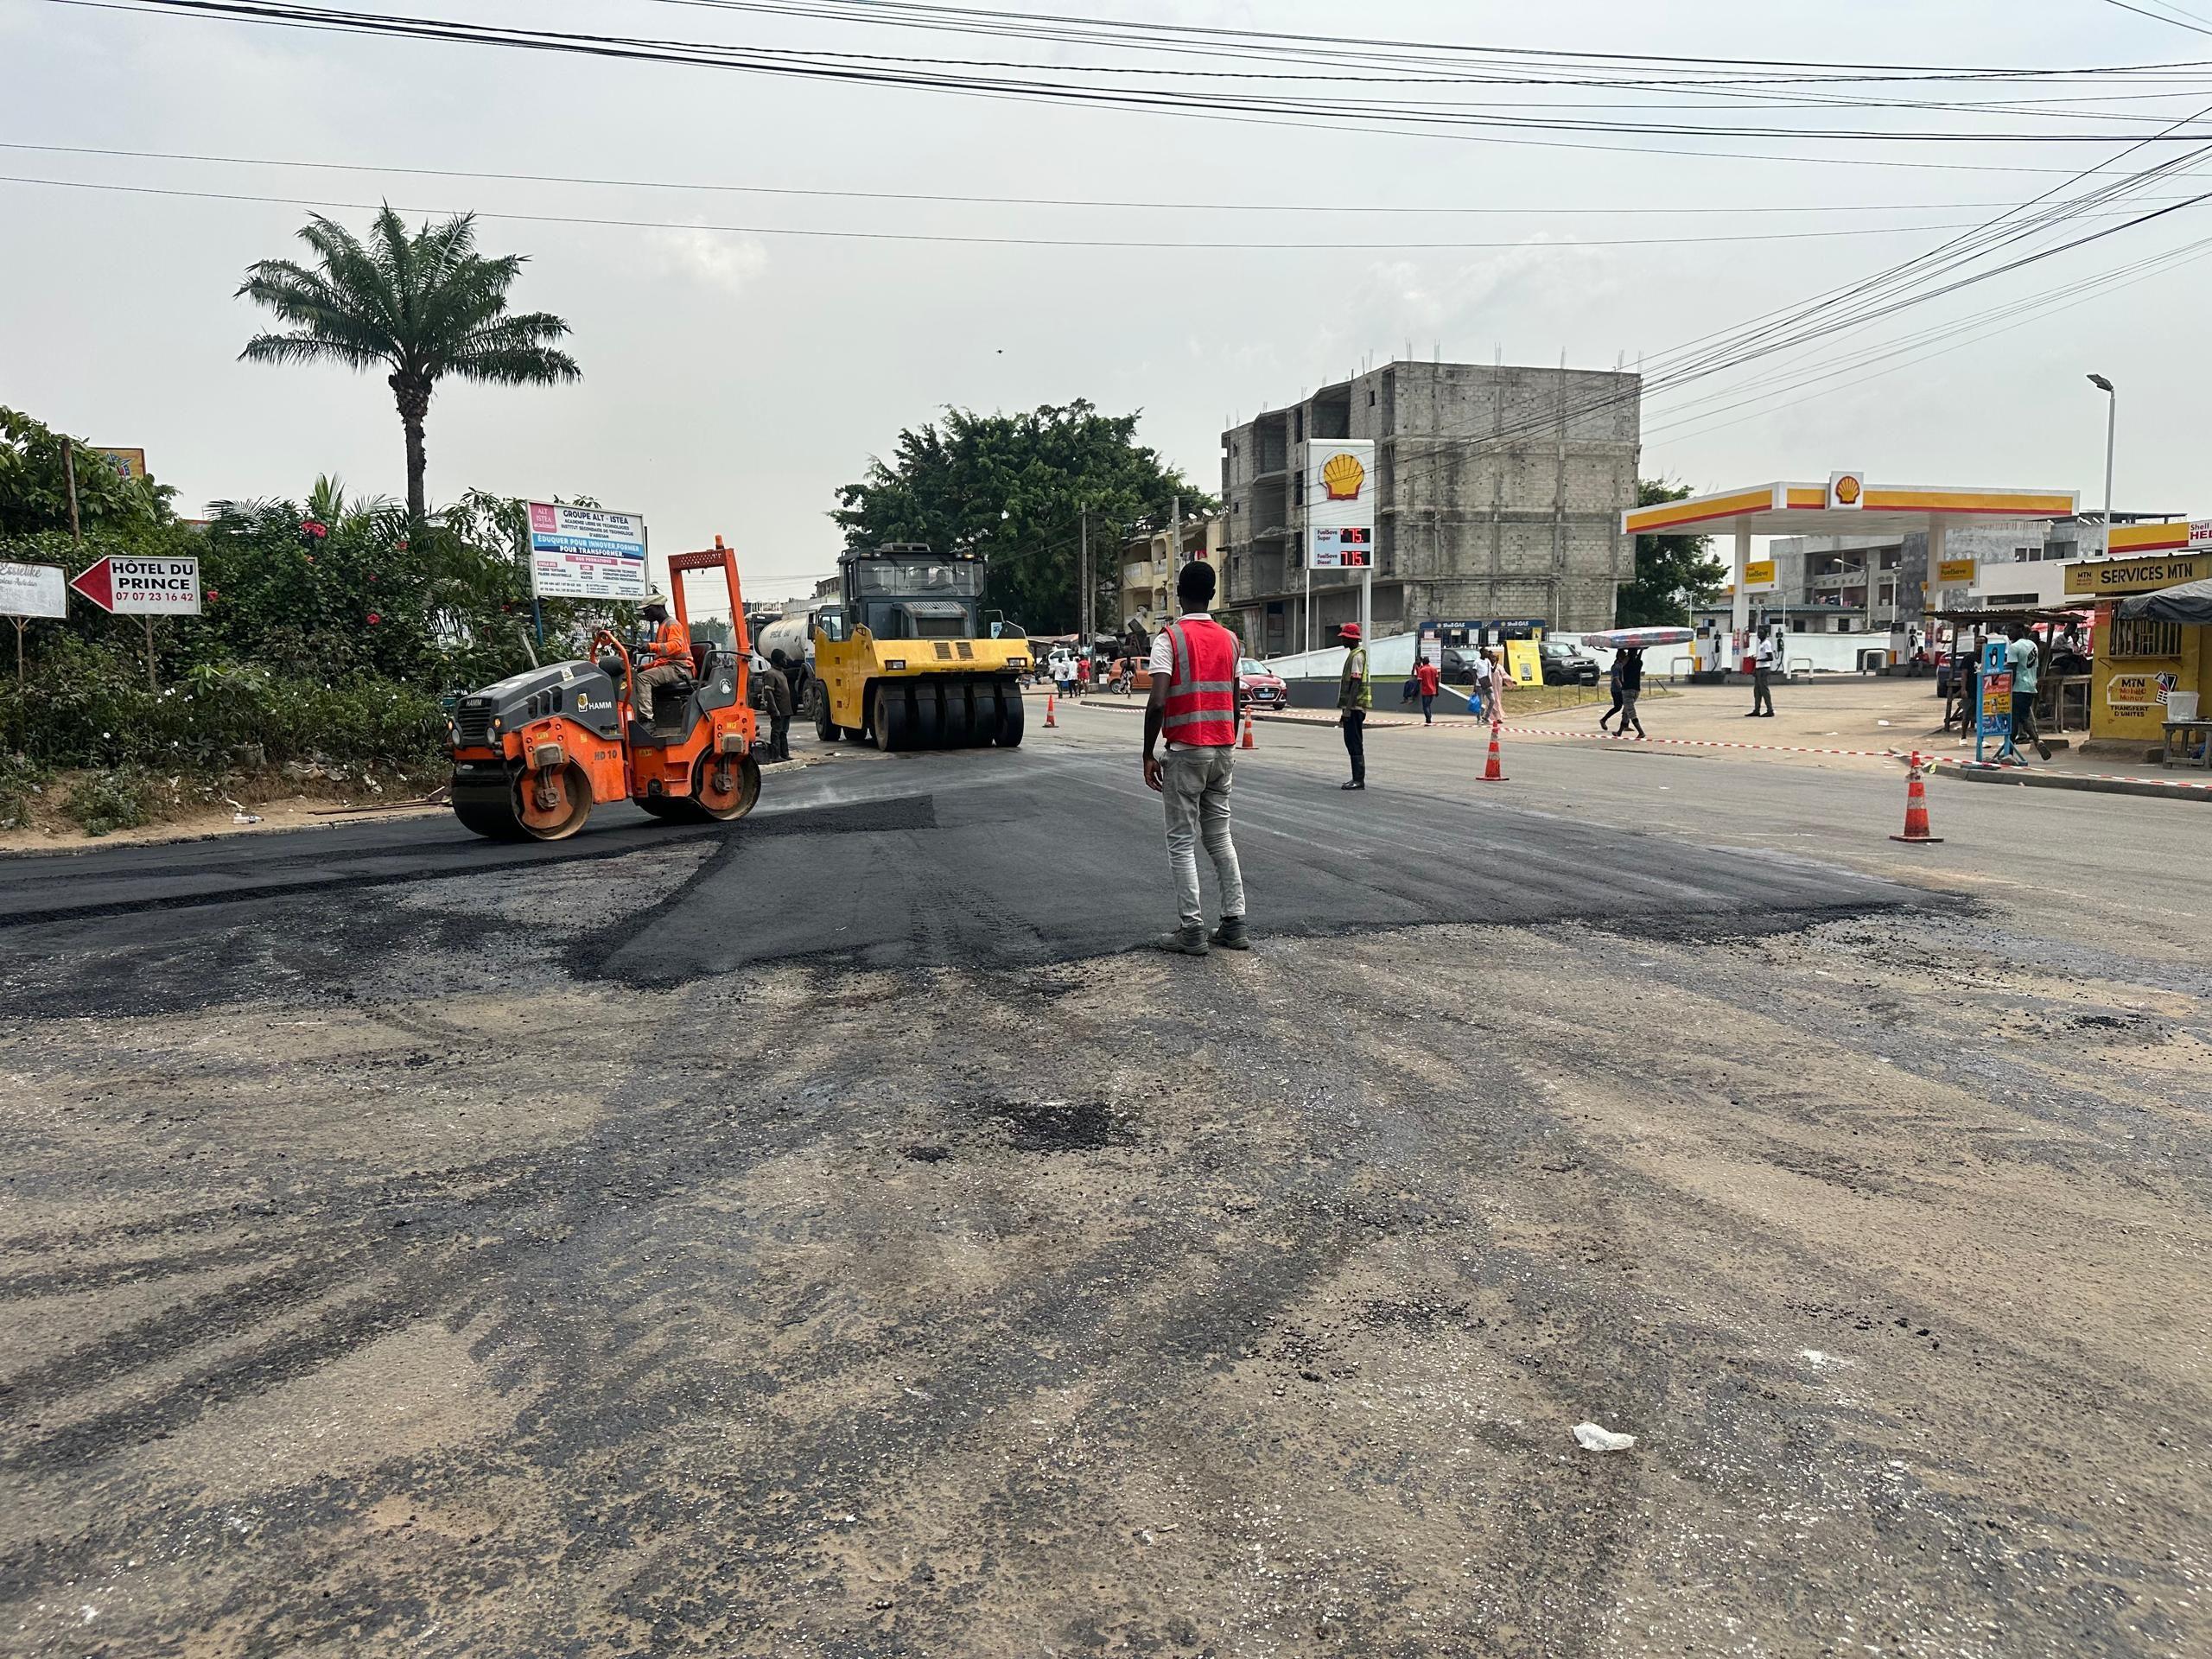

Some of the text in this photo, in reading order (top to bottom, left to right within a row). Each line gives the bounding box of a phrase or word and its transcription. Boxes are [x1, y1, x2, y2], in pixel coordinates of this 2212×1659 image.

[563, 510, 590, 520] GROUPE
[610, 515, 628, 524] ISTEA
[2190, 523, 2209, 531] Shell
[111, 559, 194, 575] HÔTEL DU
[2101, 563, 2193, 584] SERVICES MTN
[118, 577, 190, 590] PRINCE
[116, 592, 194, 602] 07 07 23 16 42
[2121, 678, 2145, 688] MTN
[466, 698, 482, 707] HAMM
[588, 701, 612, 710] HAMM
[594, 750, 618, 761] HD 10
